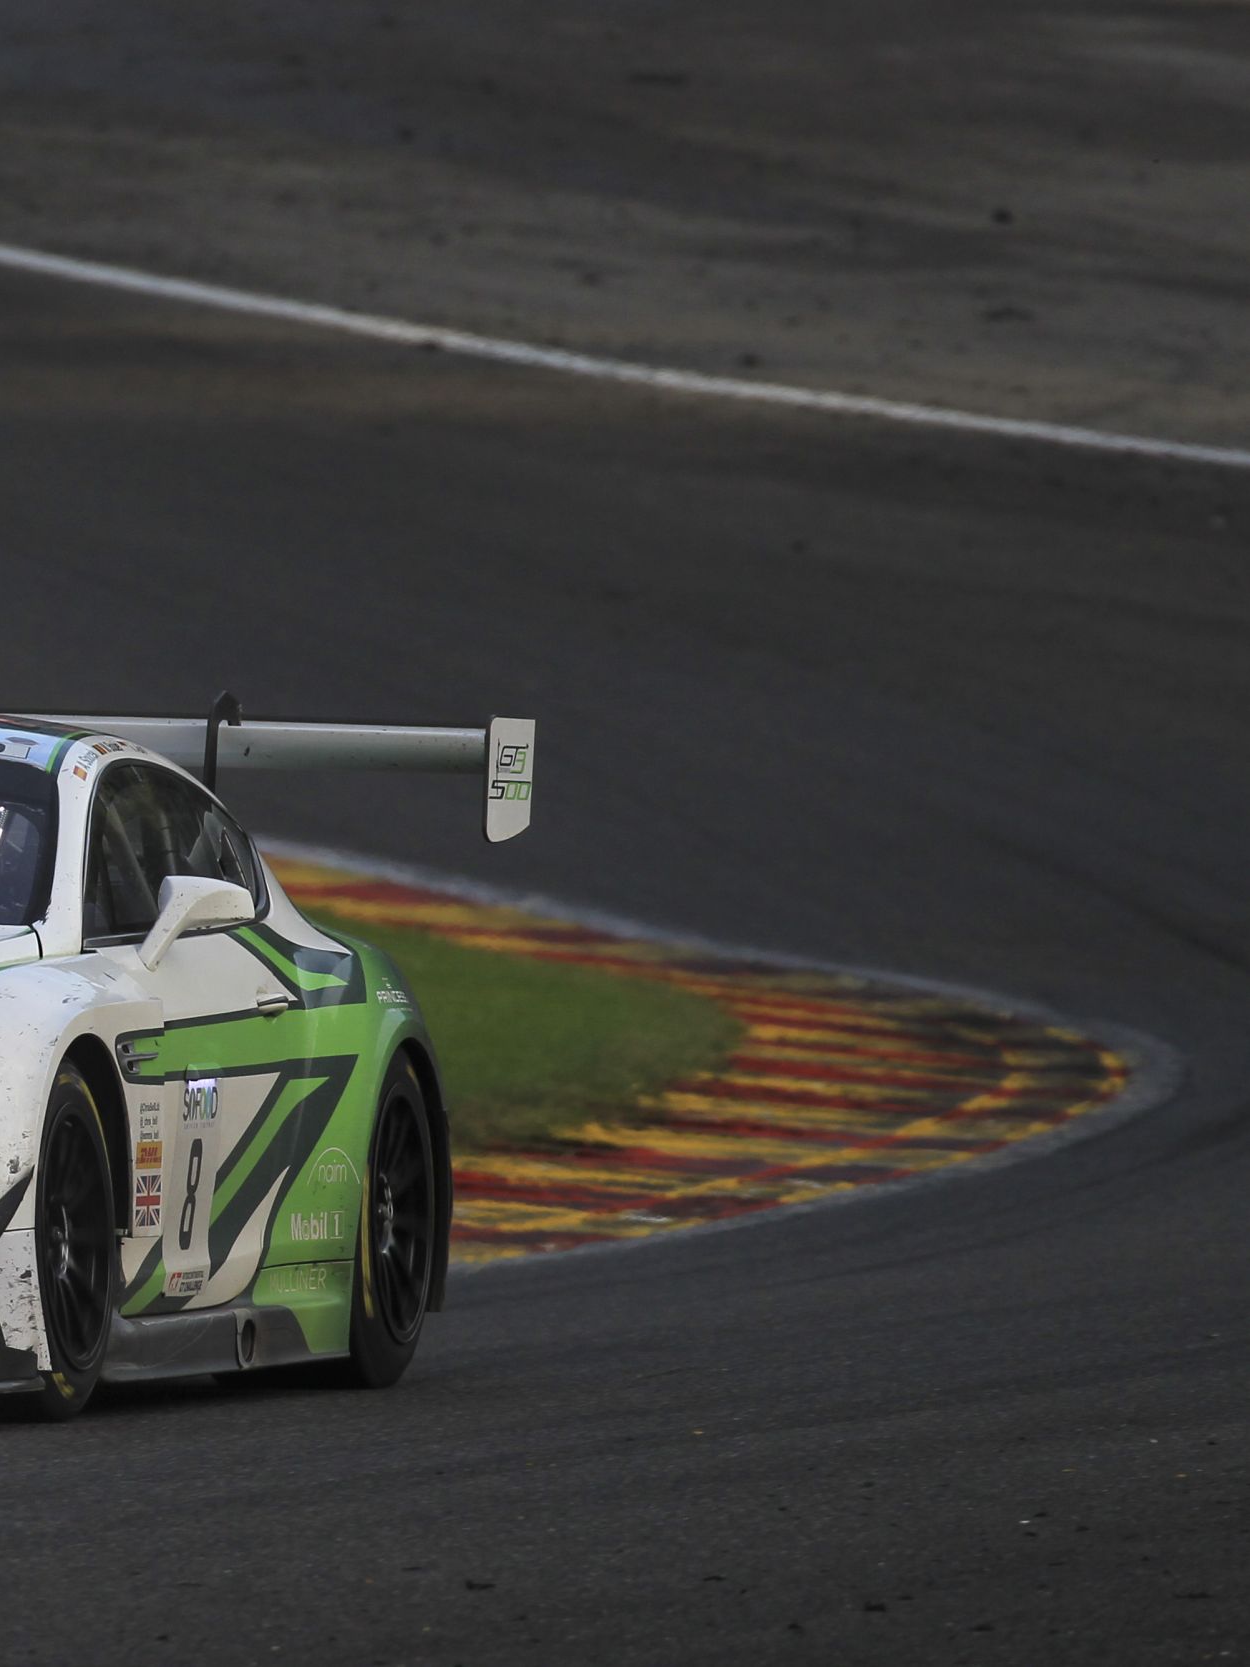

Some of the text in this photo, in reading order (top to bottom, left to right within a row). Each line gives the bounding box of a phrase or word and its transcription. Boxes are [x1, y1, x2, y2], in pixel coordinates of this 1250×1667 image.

[499, 743, 529, 774] GT3
[489, 780, 532, 800] 500
[318, 1159, 347, 1184] naim
[178, 1138, 203, 1251] 8
[291, 1211, 328, 1241] Mobil
[269, 1268, 327, 1294] MULLINER
